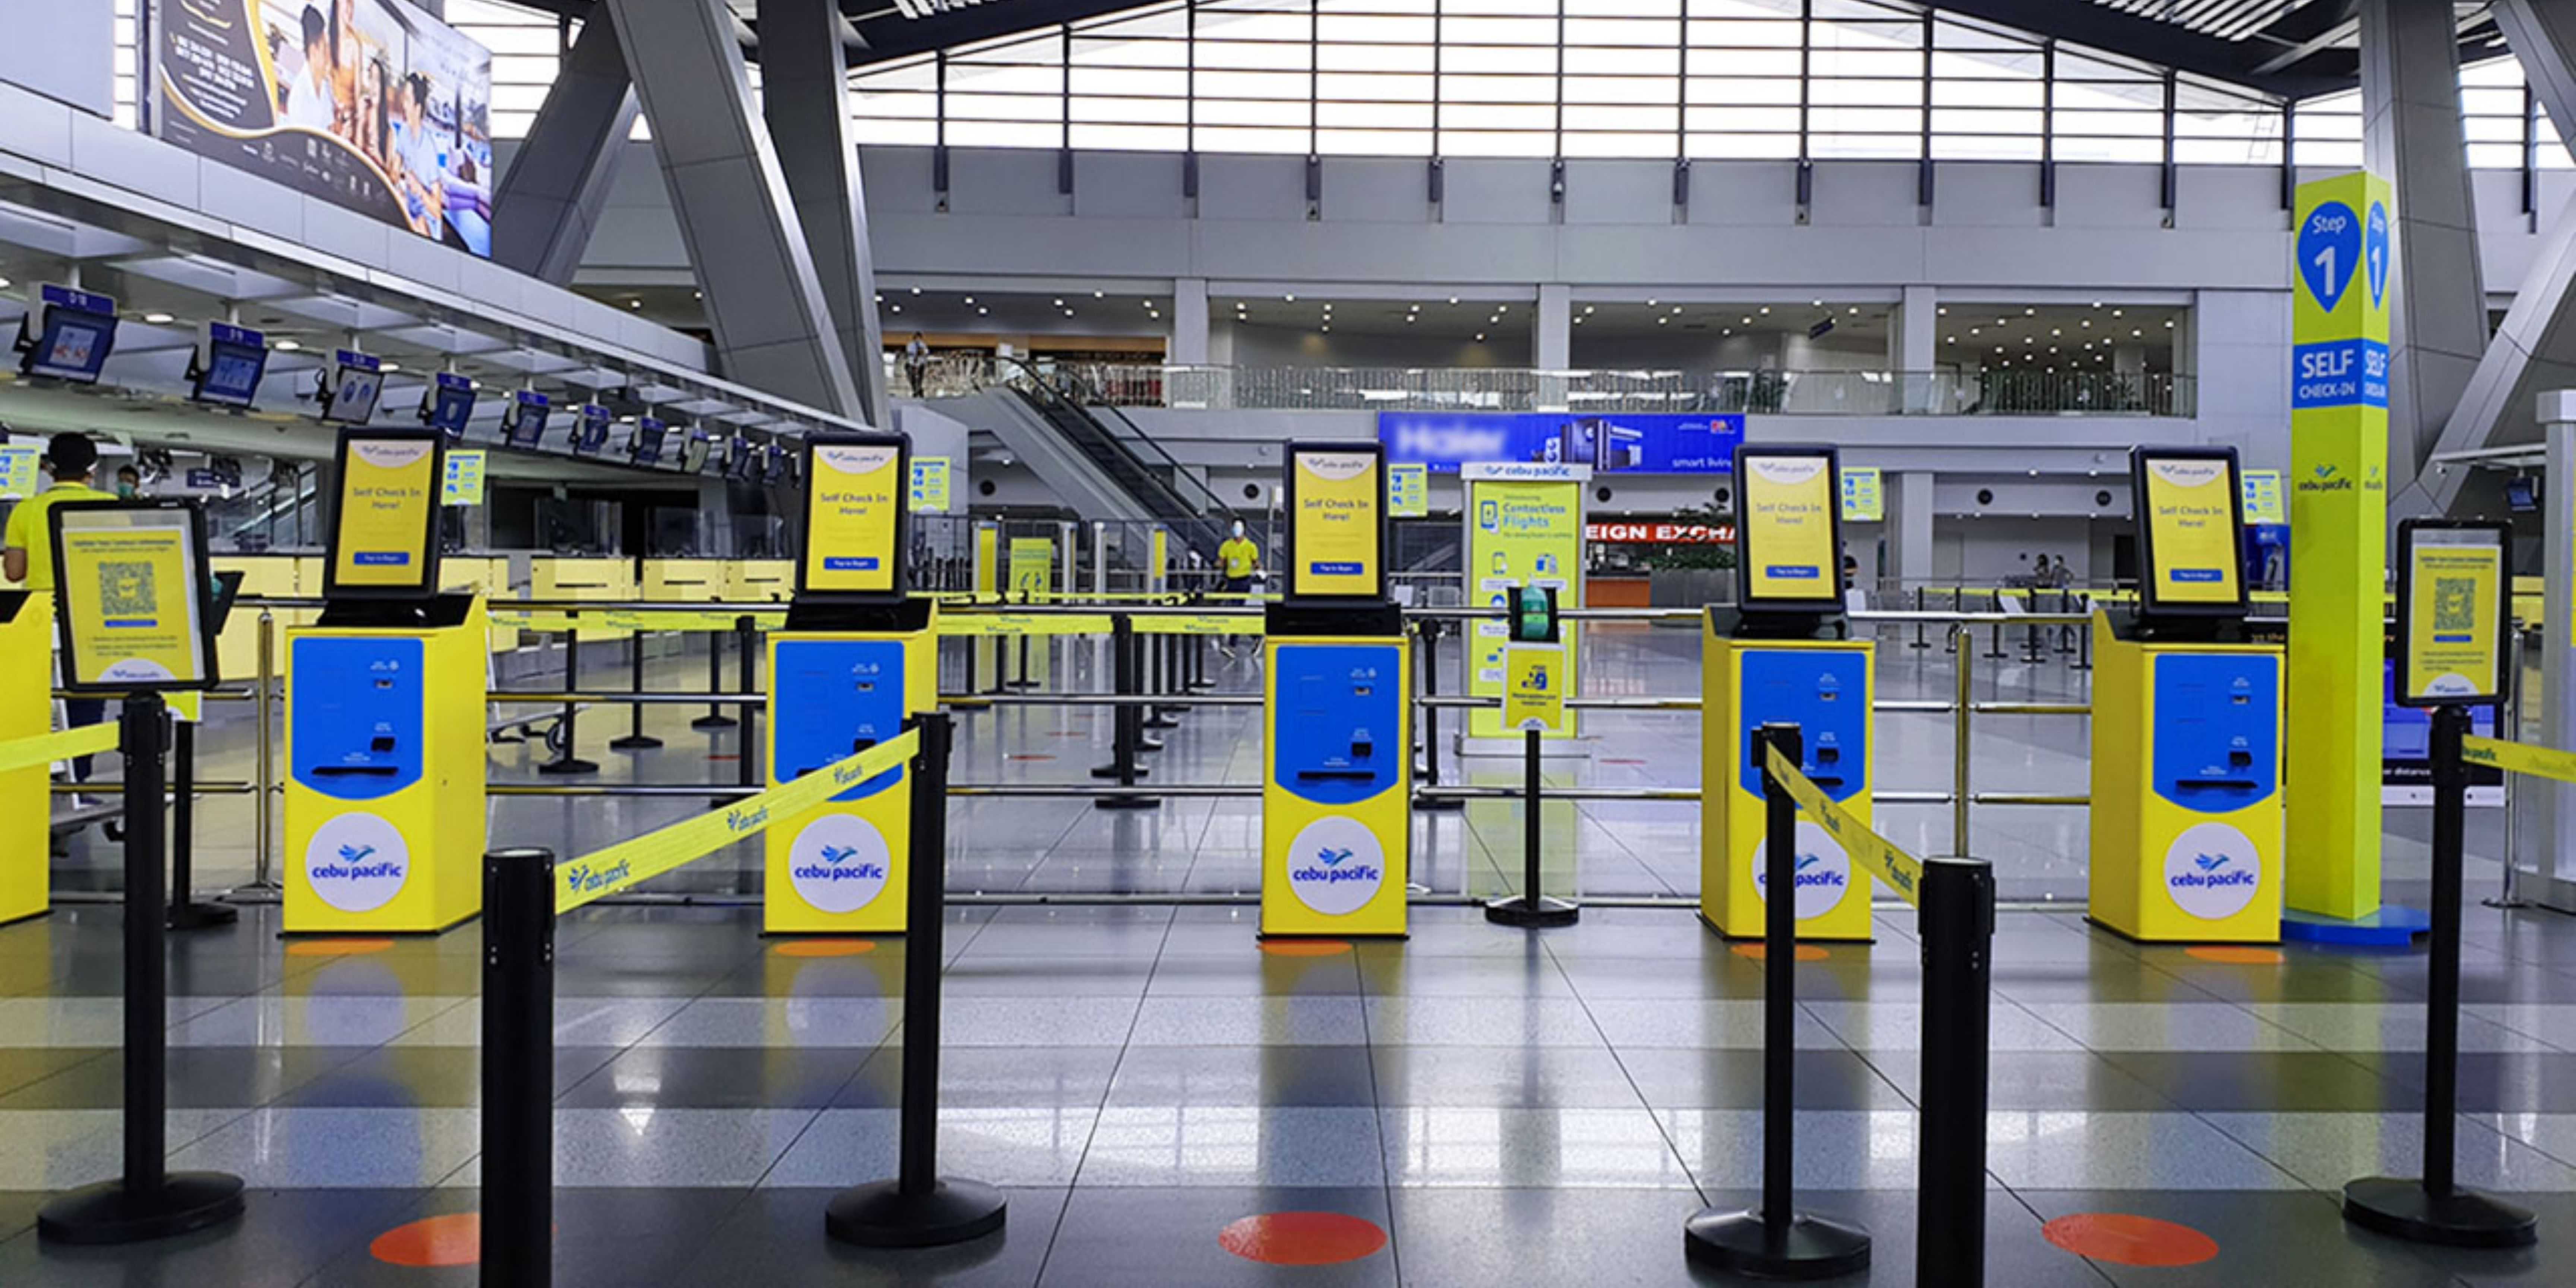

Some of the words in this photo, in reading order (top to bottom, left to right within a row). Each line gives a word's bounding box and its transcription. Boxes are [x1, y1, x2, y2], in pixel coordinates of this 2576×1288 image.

[2312, 214, 2346, 235] Step
[2314, 246, 2336, 296] 1
[2371, 246, 2381, 295] 1
[2301, 349, 2354, 379] SELF
[2299, 381, 2355, 399] CHECK-IN
[1672, 458, 1705, 468] smart
[1505, 467, 1532, 476] cebu
[1534, 466, 1571, 477] pacific
[353, 487, 373, 497] Self
[376, 487, 406, 497] Check
[410, 488, 421, 497] In
[820, 493, 839, 503] Self
[842, 493, 872, 503] Check
[877, 493, 888, 502] In
[372, 500, 400, 509] Here!
[1304, 499, 1323, 509] Self
[1325, 499, 1355, 509] Check
[1358, 499, 1369, 508] In
[1503, 503, 1566, 514] Contactless
[1756, 503, 1775, 513] Self
[1778, 503, 1807, 513] Check
[1811, 503, 1822, 512] In
[839, 506, 868, 515] Here!
[2159, 505, 2178, 515] Self
[2180, 505, 2209, 515] Check
[2212, 506, 2223, 515] In
[1323, 512, 1350, 521] Here!
[1775, 516, 1804, 525] Here!
[1504, 515, 1549, 530] Flights
[2178, 518, 2206, 528] Here!
[312, 863, 348, 878] cebu
[350, 861, 402, 881] pacific
[794, 864, 831, 879] cebu
[833, 862, 883, 881] pacific
[1293, 866, 1328, 881] cebu
[1330, 864, 1379, 884] pacific
[1796, 870, 1844, 888] pacific
[2171, 871, 2205, 887] cebu
[2207, 869, 2254, 888] pacific
